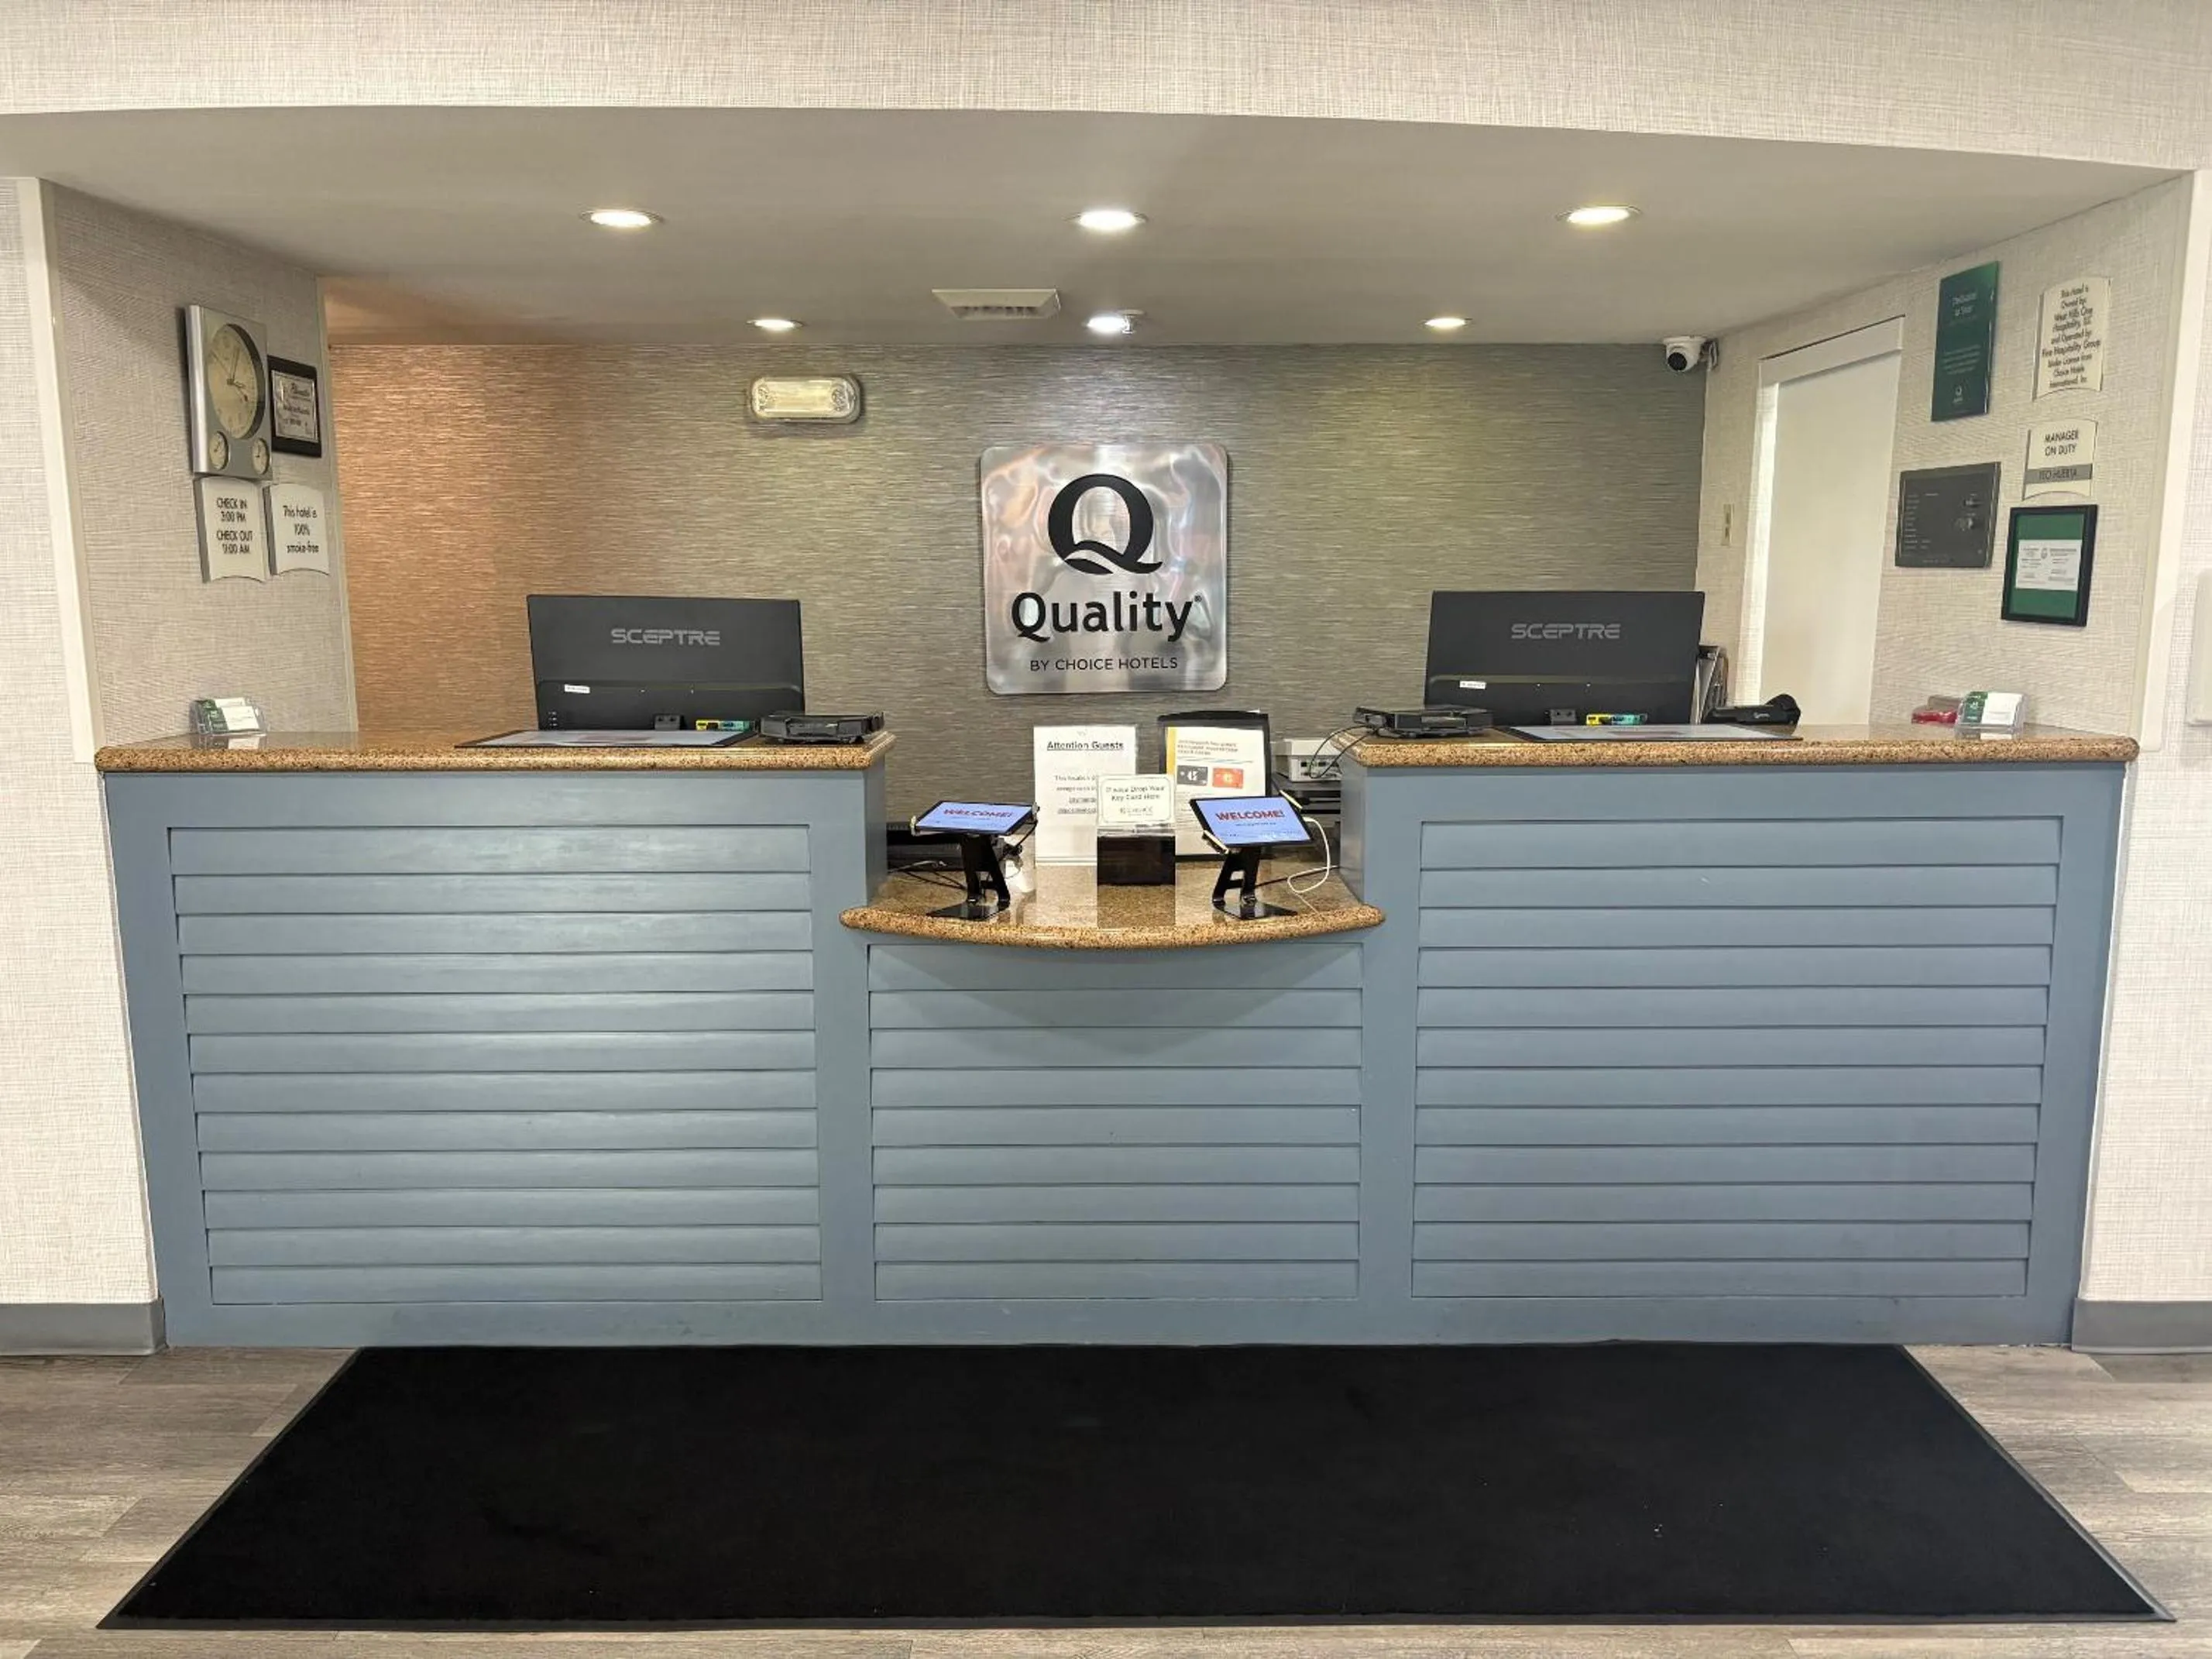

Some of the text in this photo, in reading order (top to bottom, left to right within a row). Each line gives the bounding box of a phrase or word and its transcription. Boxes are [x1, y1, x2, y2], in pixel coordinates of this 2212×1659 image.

[2045, 428, 2079, 443] MANAGER
[2045, 443, 2077, 456] ON DUTY
[216, 496, 248, 510] CHECK IN
[221, 510, 246, 522] 3:00 PM
[282, 505, 295, 518] This
[296, 506, 310, 518] hotel
[1048, 473, 1163, 575] Q
[216, 530, 253, 541] CHECK OUT
[239, 544, 250, 555] AM
[286, 541, 319, 555] smoke-free
[1012, 591, 1194, 642] Quality
[611, 628, 720, 645] SCEPTRE
[1511, 623, 1621, 640] SCEPTRE
[1030, 658, 1178, 672] BY CHOICE HOTELS
[1047, 741, 1125, 750] Attention Guests
[943, 808, 1013, 818] WELCOME!
[1215, 809, 1286, 822] WELCOME!
